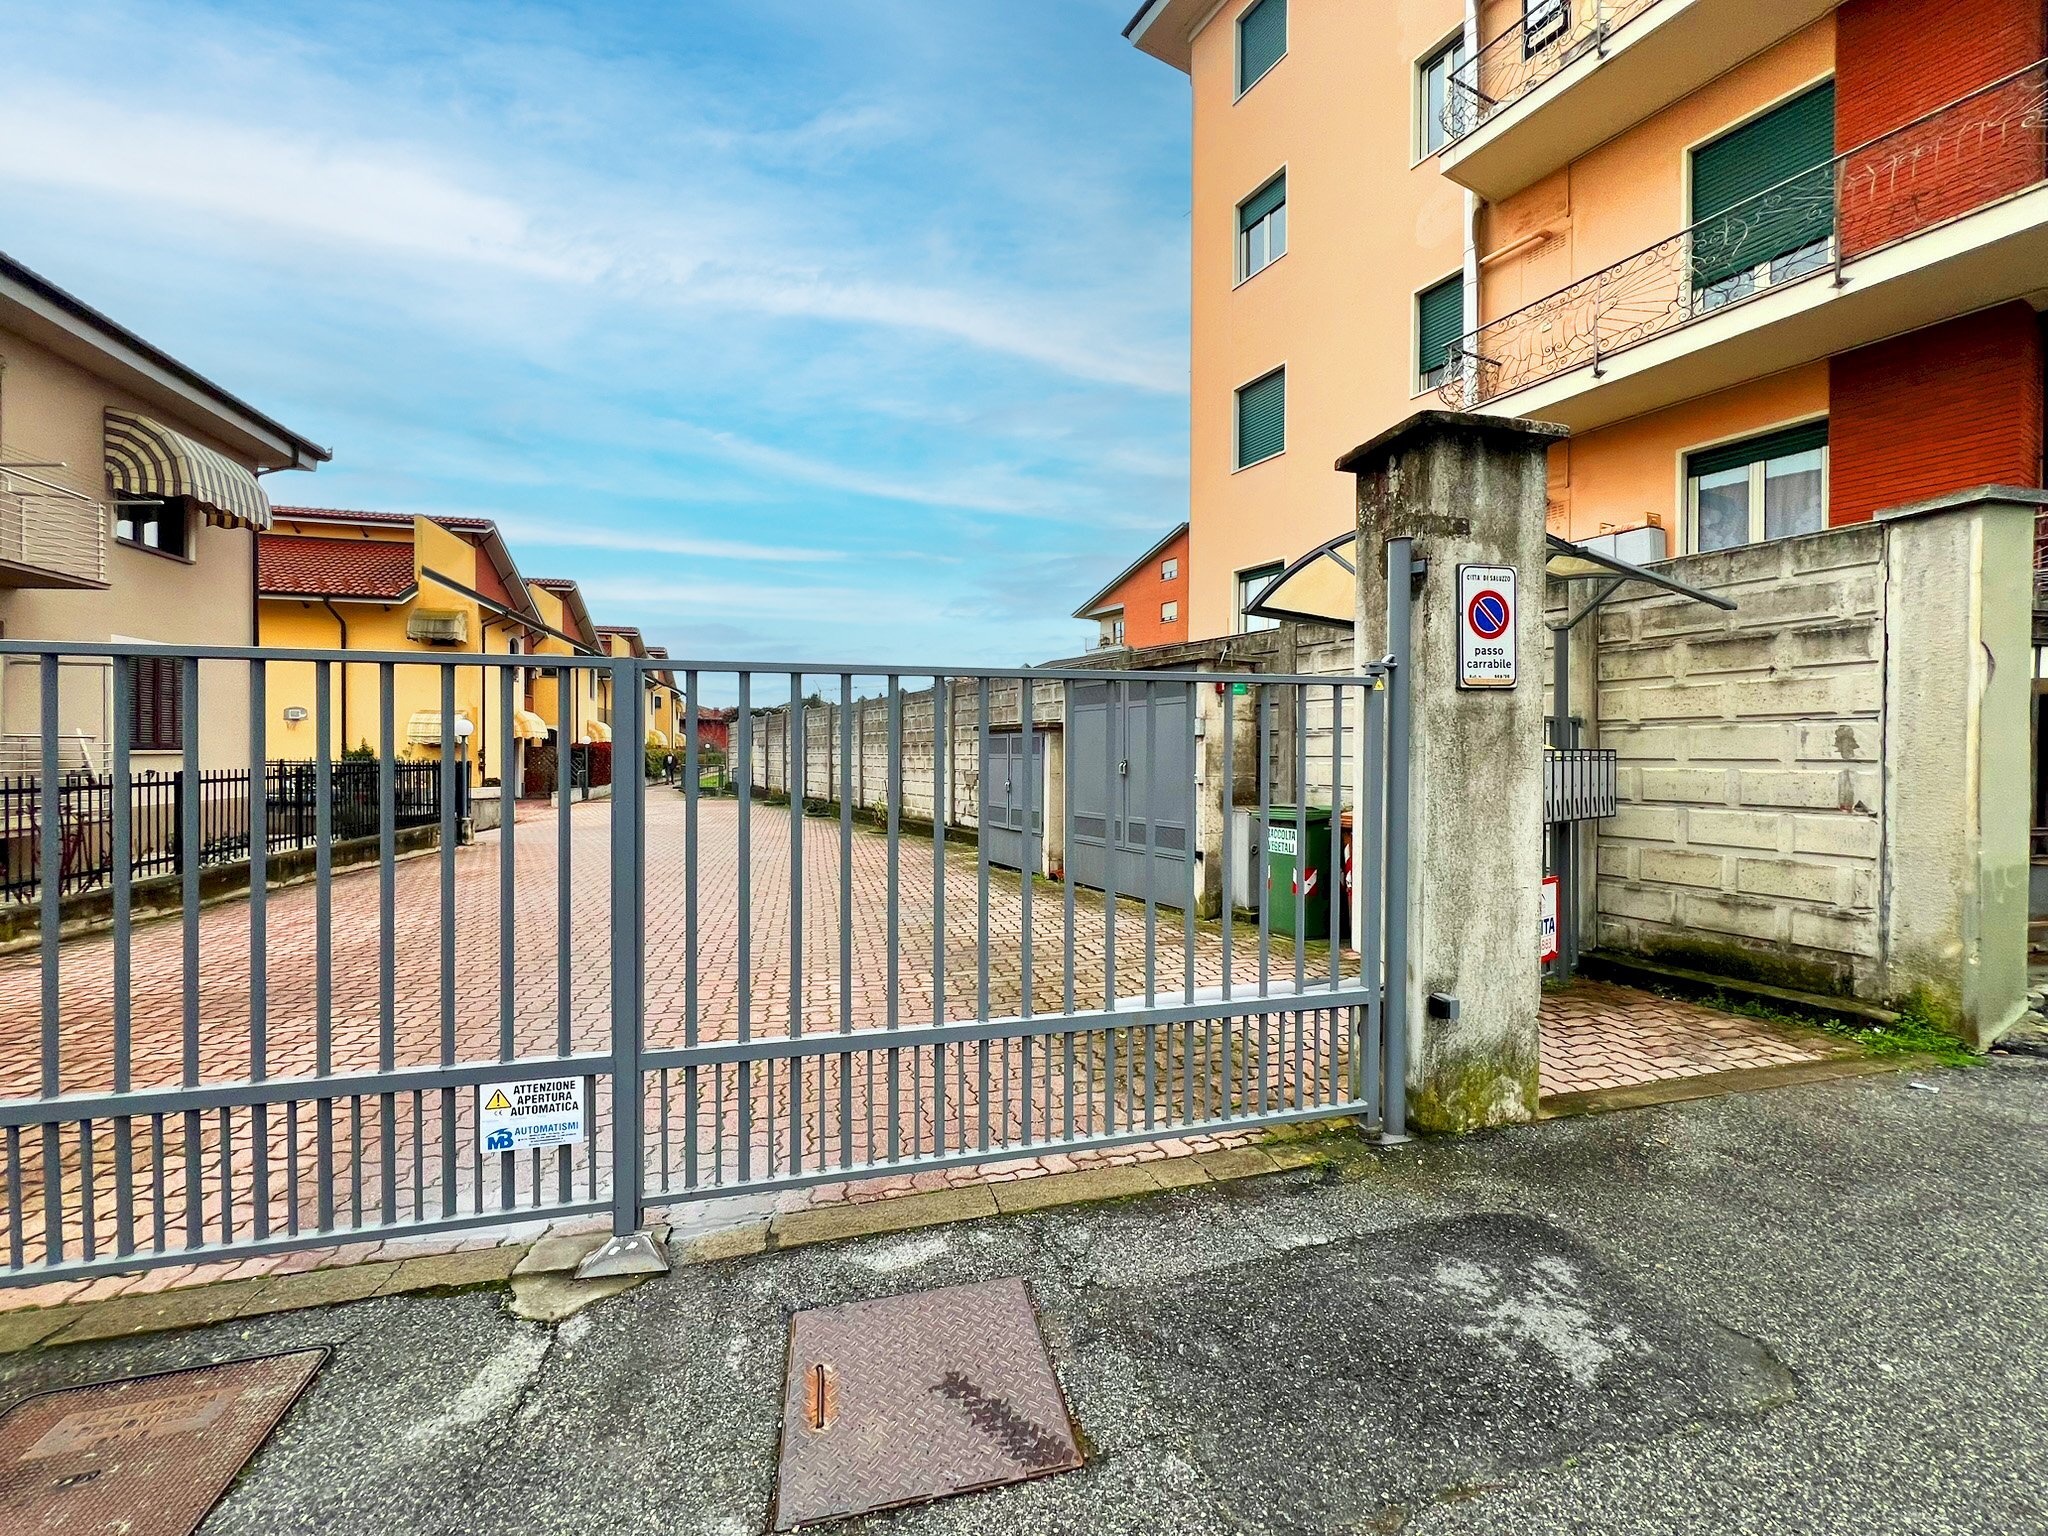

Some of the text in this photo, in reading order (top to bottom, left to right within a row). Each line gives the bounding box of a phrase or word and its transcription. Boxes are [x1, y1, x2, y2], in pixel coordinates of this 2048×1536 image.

[1474, 647, 1504, 657] passo
[1466, 659, 1512, 669] carrabile
[513, 1080, 576, 1095] ATTENZIONE
[517, 1091, 573, 1105] APERTURA
[510, 1101, 579, 1116] AUTOMATICA
[514, 1121, 579, 1136] AUTOMATISMI
